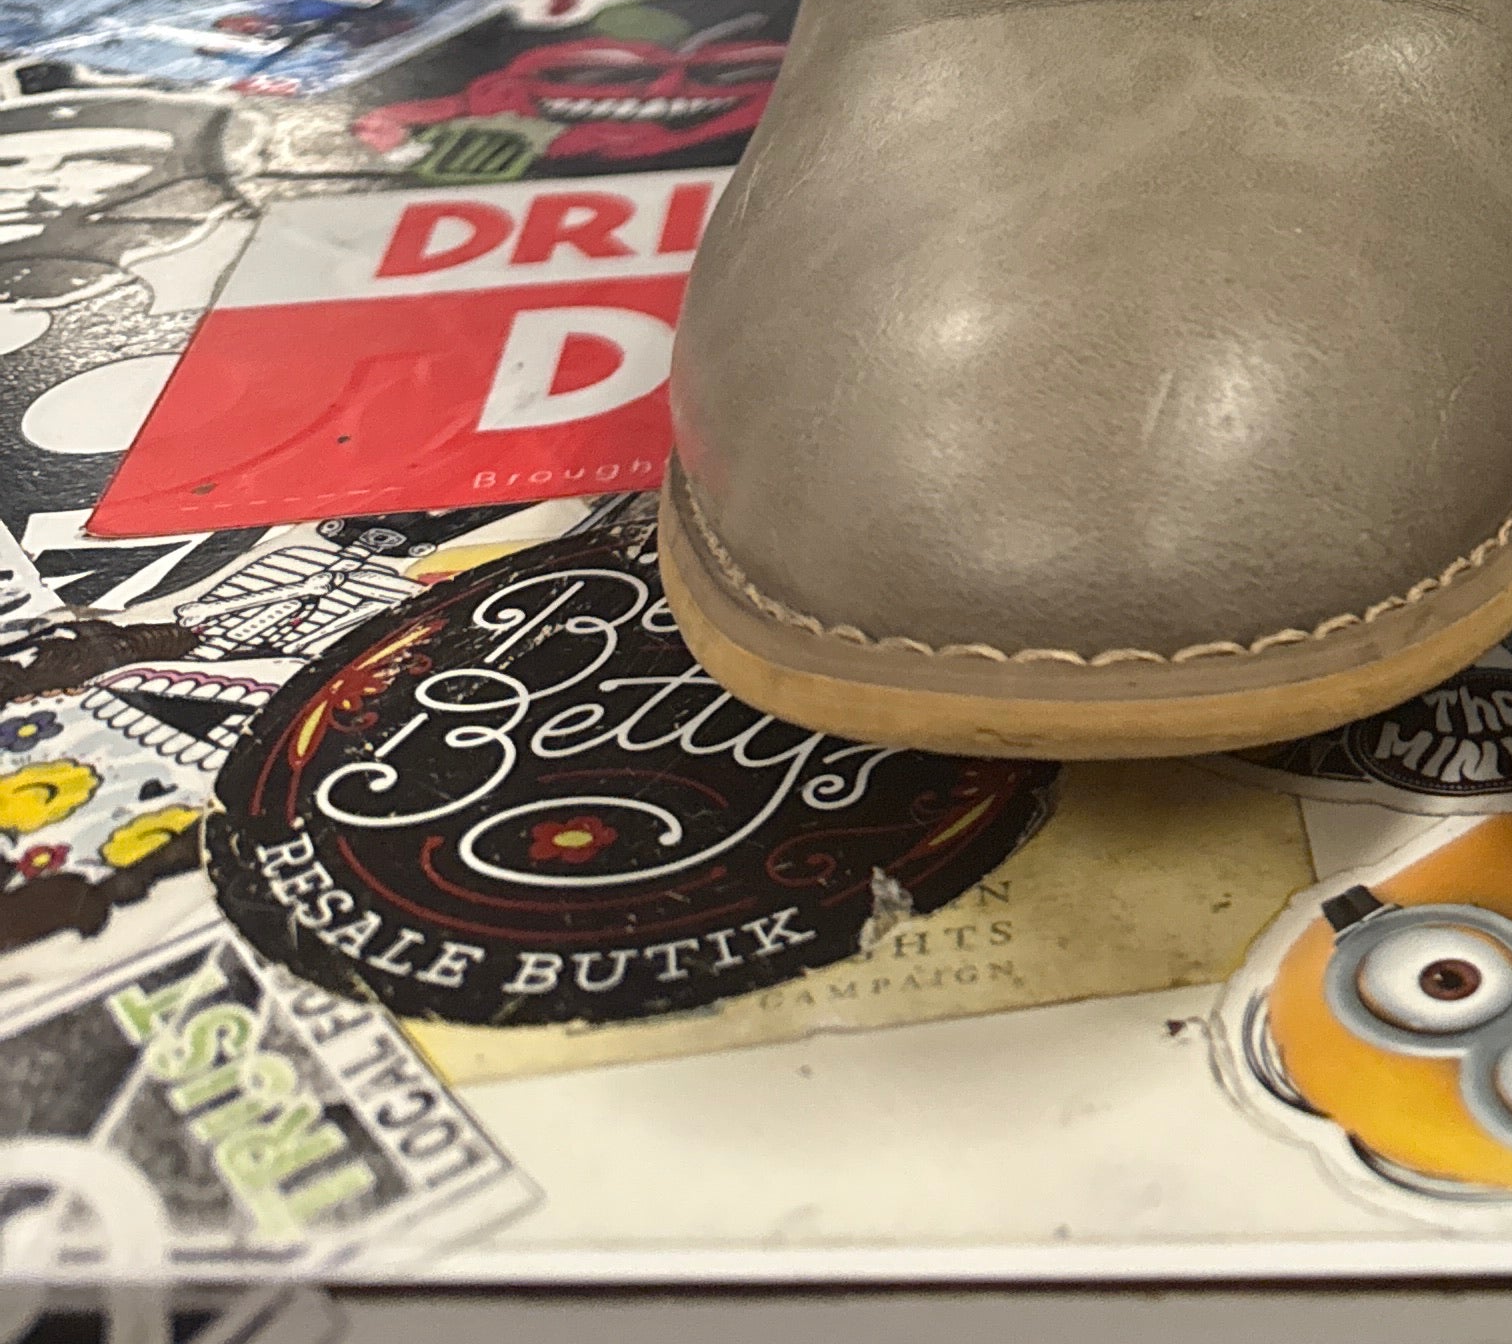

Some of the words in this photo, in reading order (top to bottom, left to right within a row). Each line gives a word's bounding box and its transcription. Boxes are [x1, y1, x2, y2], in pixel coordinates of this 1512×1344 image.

[256, 830, 486, 990] RESALE
[502, 906, 818, 997] BUTIK
[758, 959, 1016, 1012] CAMPAIGN
[109, 964, 378, 1240] TRUST
[342, 1042, 483, 1190] LOCAL
